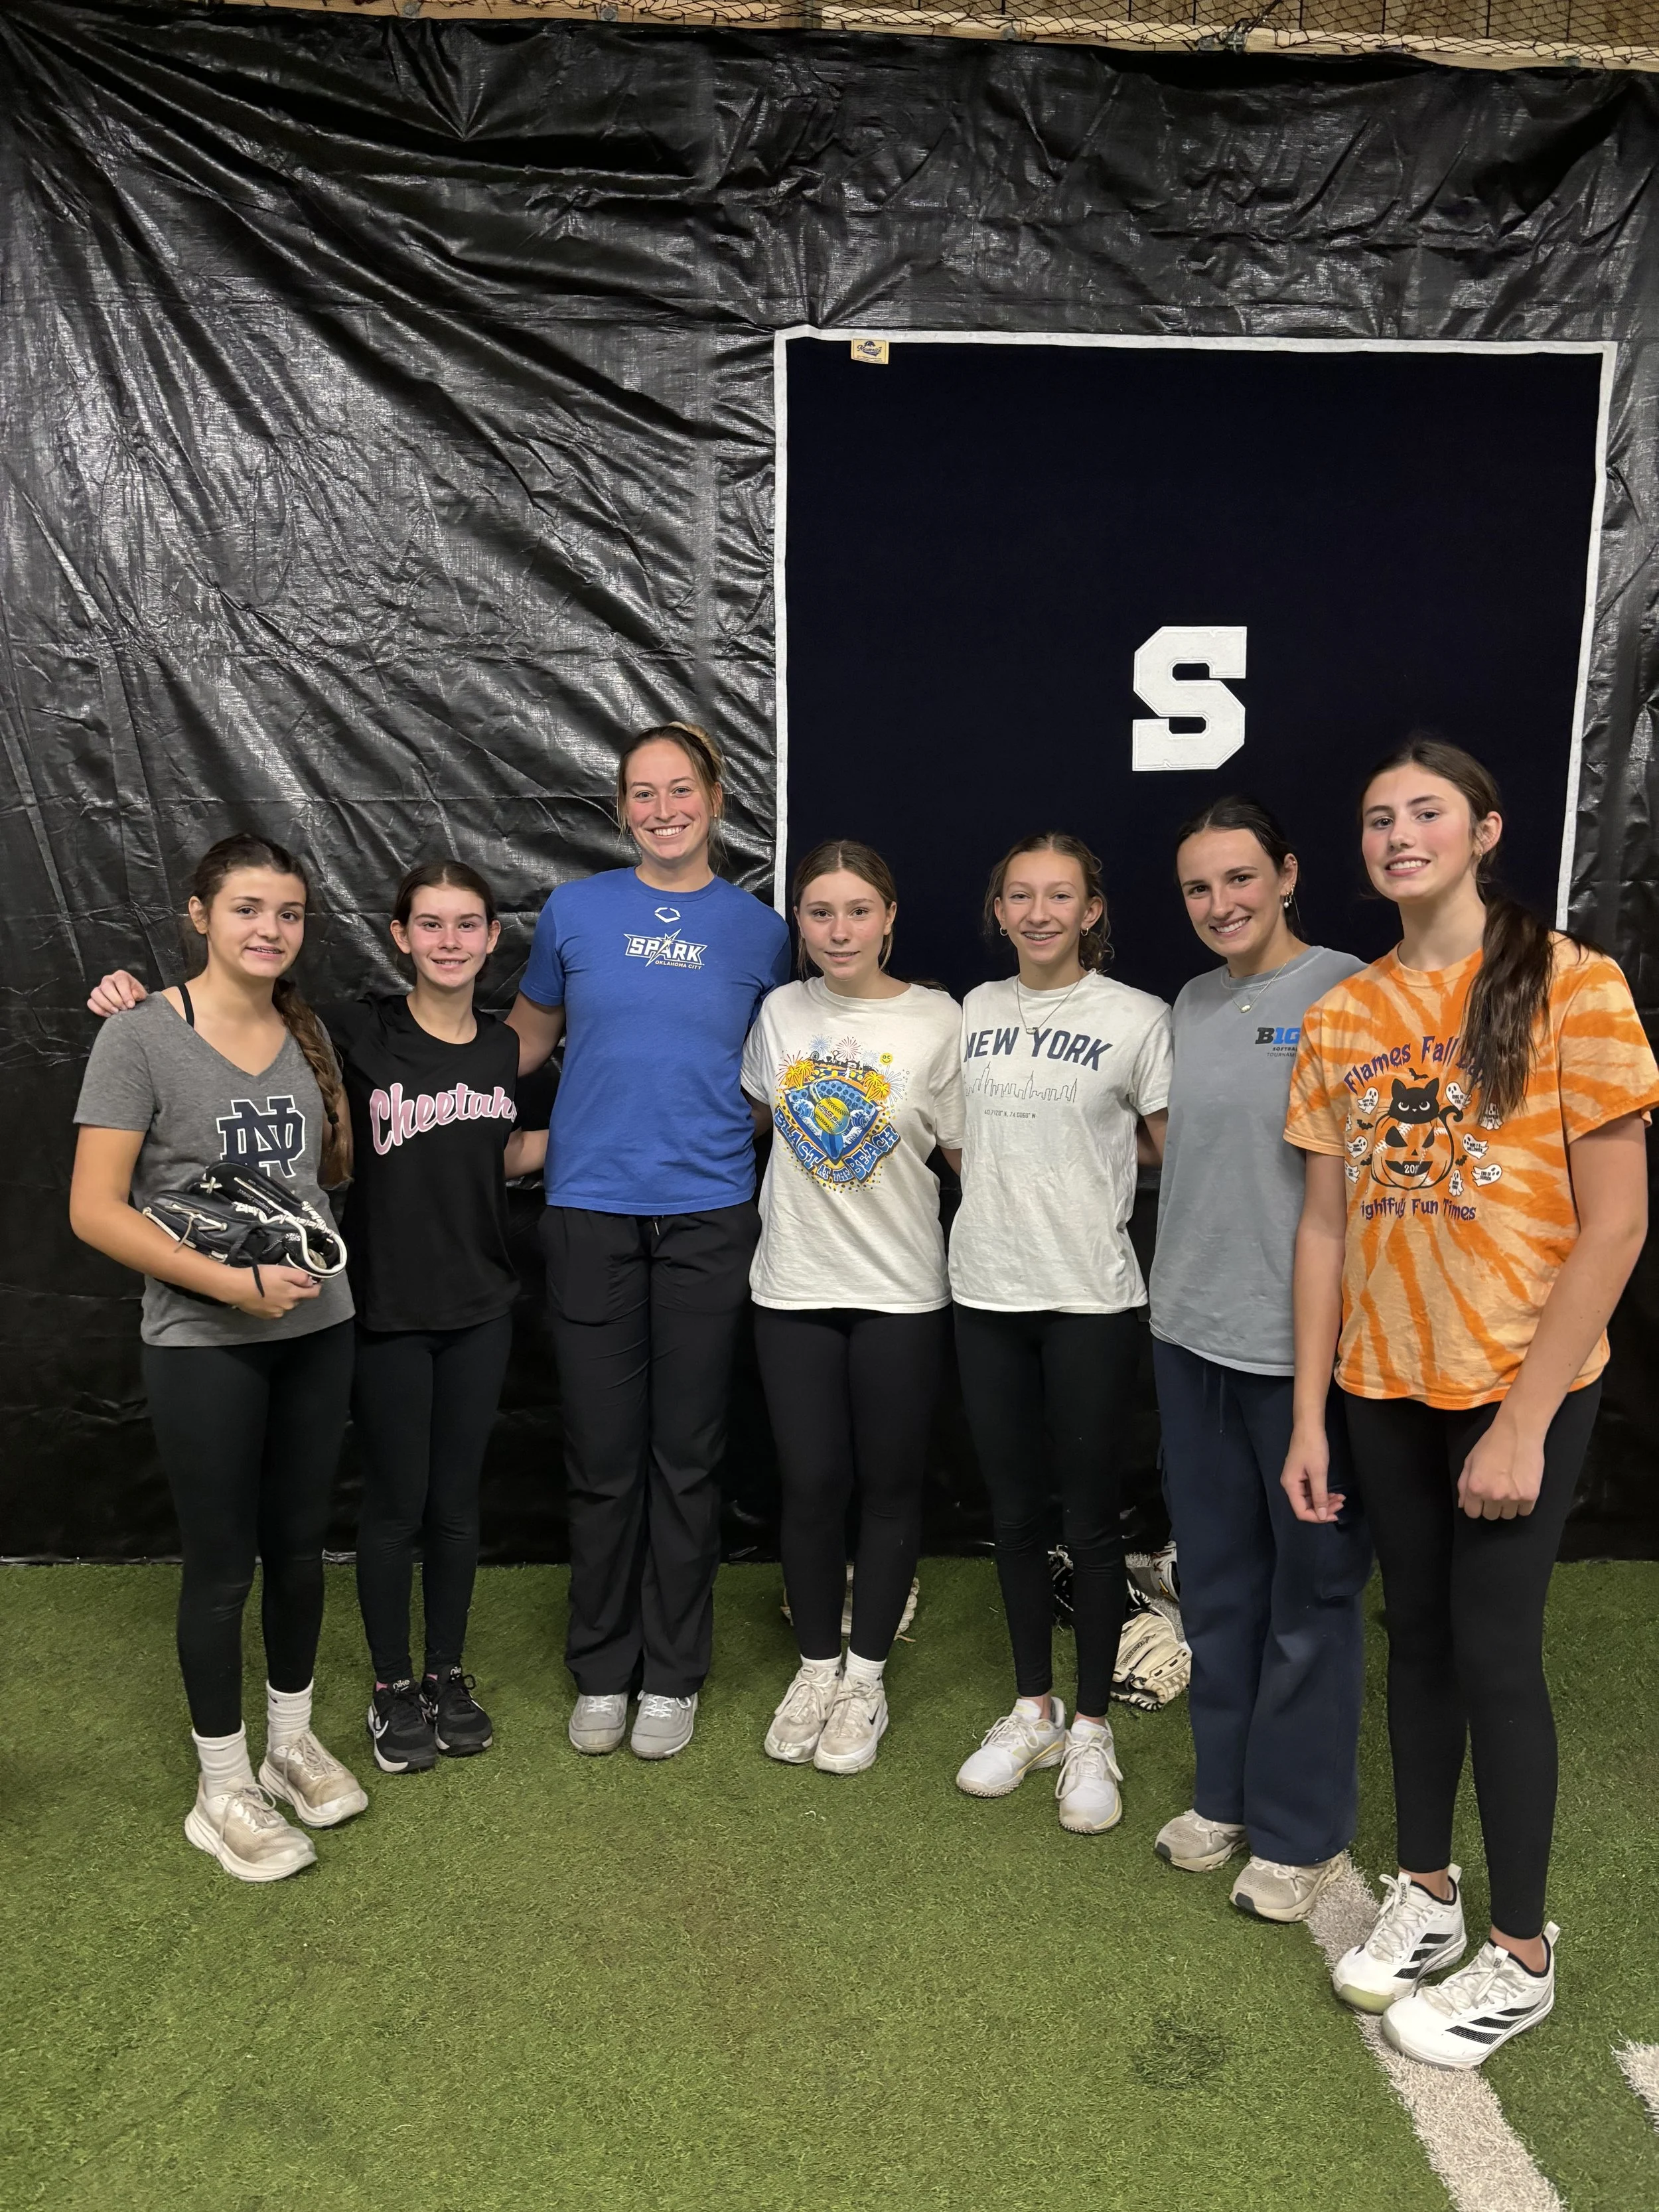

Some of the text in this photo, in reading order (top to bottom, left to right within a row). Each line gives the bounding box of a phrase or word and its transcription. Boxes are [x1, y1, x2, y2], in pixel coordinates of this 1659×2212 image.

[1132, 626, 1248, 772] S
[628, 936, 704, 964] SPARK
[964, 1027, 1113, 1071] NEW YORK
[1344, 1043, 1411, 1095] Flames
[1421, 1035, 1460, 1067] Fall
[774, 1108, 900, 1181] BLAST AT THE BEACH
[1404, 1164, 1419, 1175] 20
[1412, 1199, 1439, 1216] Fun
[1443, 1197, 1477, 1221] Times
[393, 1679, 410, 1690] nike
